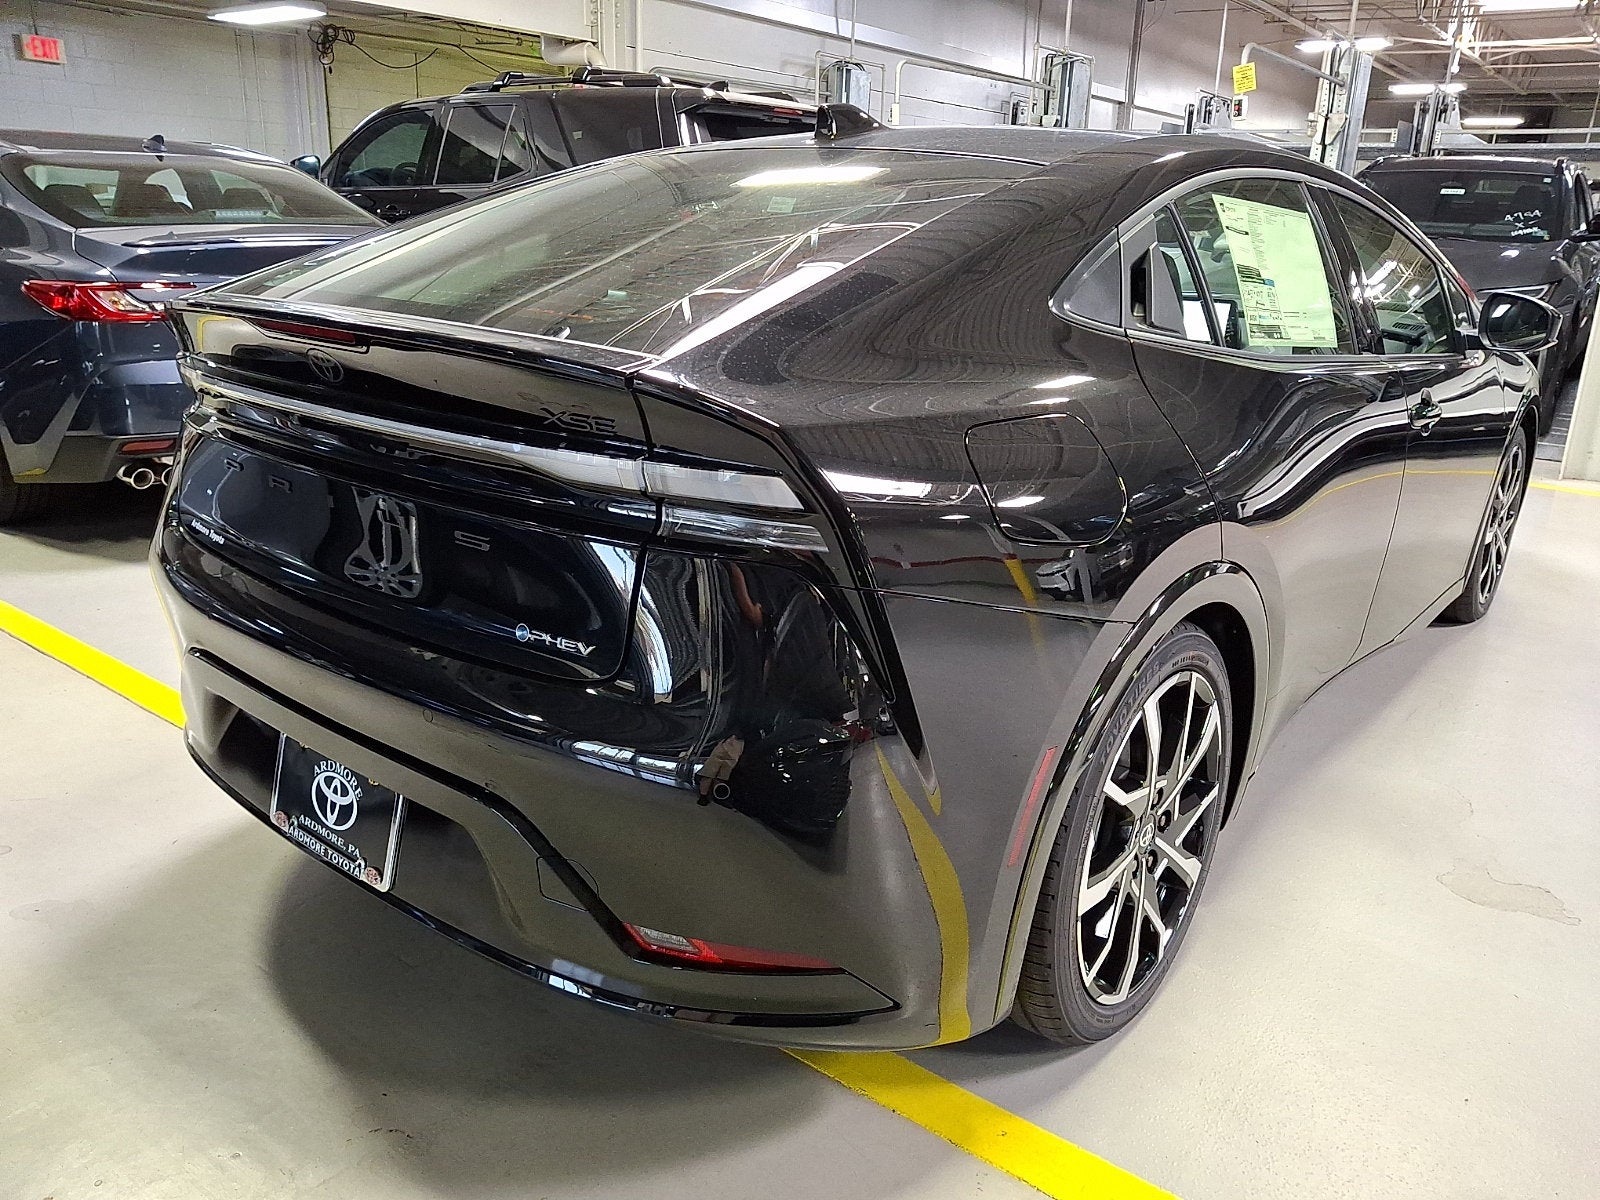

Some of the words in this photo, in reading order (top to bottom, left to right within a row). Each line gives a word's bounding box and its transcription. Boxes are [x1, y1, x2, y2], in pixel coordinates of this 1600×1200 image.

[31, 36, 59, 60] EXIT
[540, 406, 617, 436] XSE
[191, 519, 210, 536] Ardmore
[209, 529, 225, 545] Toyota
[528, 630, 597, 656] PHEV
[313, 760, 363, 801] ARDMORE
[299, 814, 347, 851] ARDMORE,
[348, 844, 361, 859] PA
[288, 826, 326, 856] ARDMORE
[327, 851, 361, 879] TOYOTA
